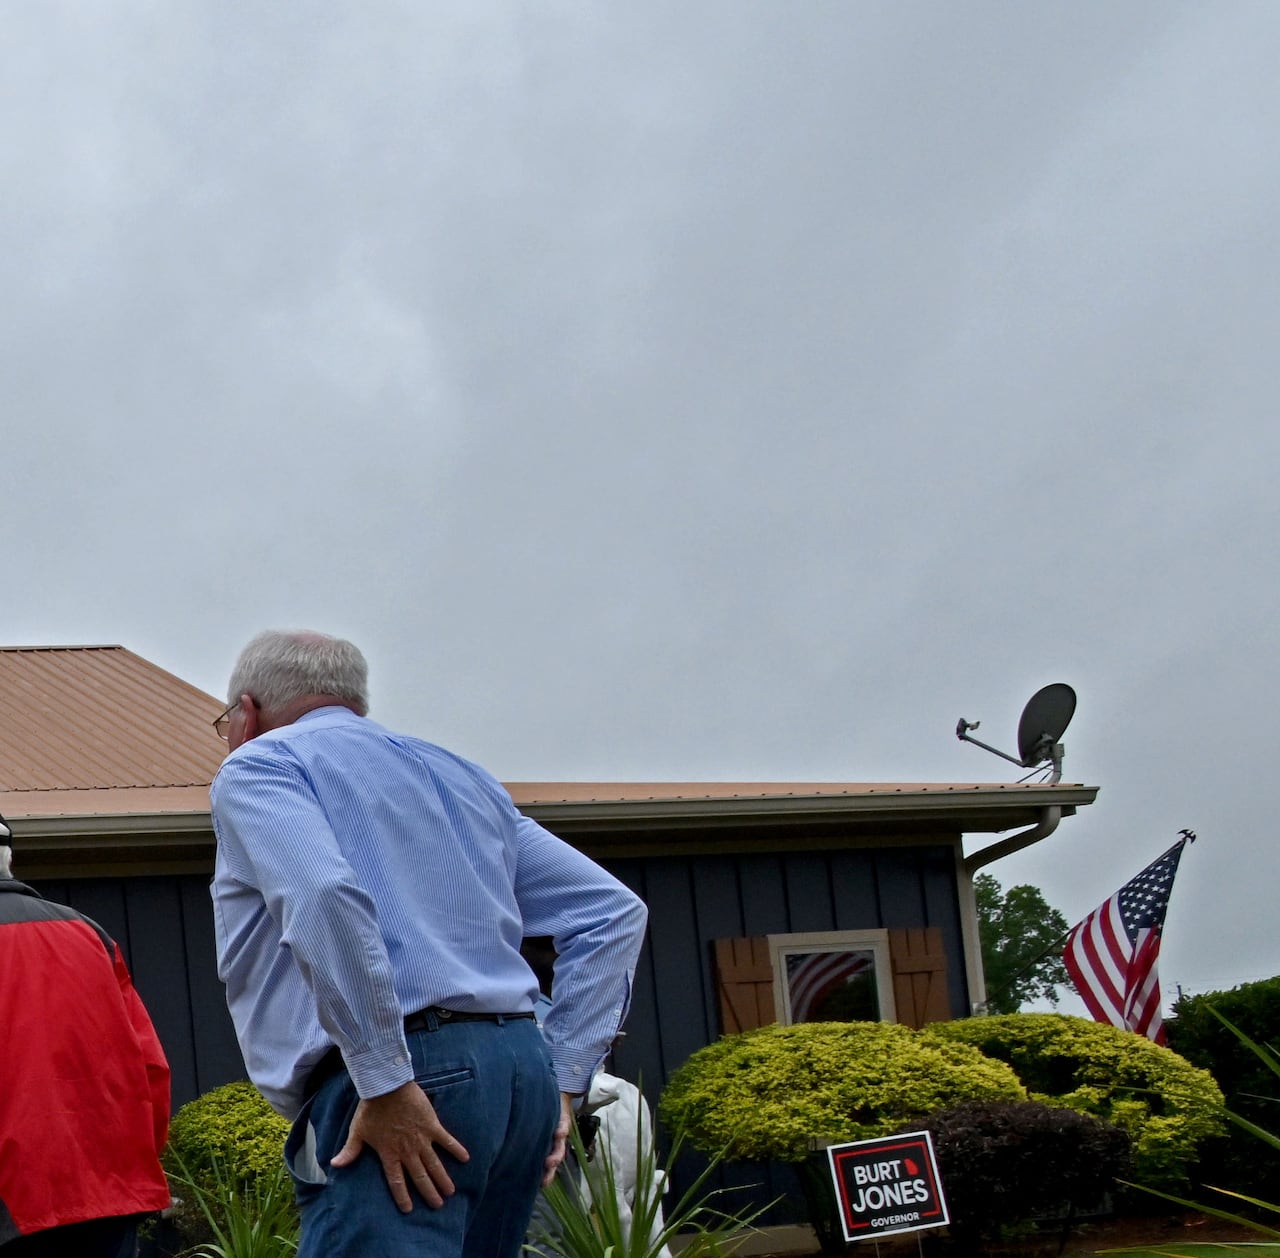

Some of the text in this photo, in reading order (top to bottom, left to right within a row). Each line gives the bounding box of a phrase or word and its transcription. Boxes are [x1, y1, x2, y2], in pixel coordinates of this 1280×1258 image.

[853, 1160, 901, 1186] BURT
[852, 1179, 929, 1213] JONES
[871, 1212, 920, 1227] GOVERNOR
